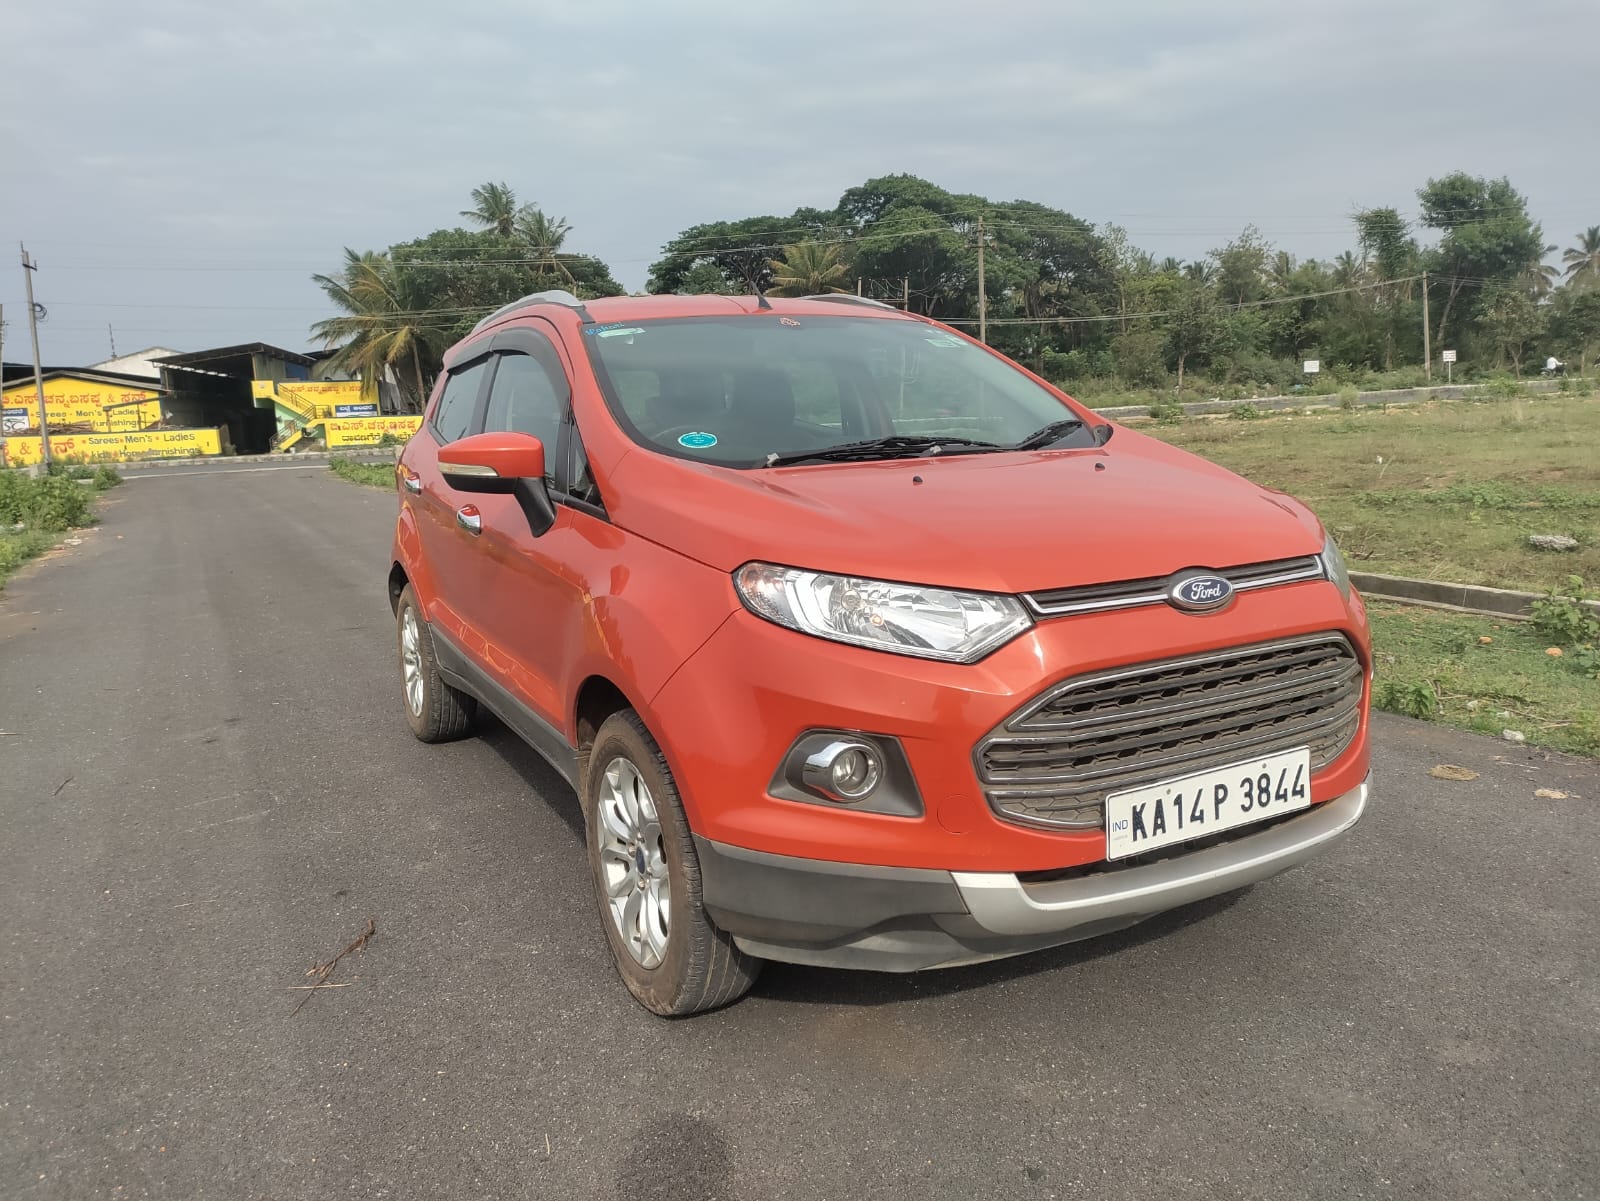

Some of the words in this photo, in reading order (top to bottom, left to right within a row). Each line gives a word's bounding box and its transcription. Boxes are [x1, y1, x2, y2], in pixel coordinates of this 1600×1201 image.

[107, 393, 116, 403] &
[88, 436, 120, 445] Sarees
[124, 434, 153, 444] Men's
[163, 432, 196, 442] Ladies
[19, 441, 32, 455] &
[1190, 580, 1222, 600] Ford
[1239, 763, 1305, 813] 3844
[1112, 819, 1129, 833] IND
